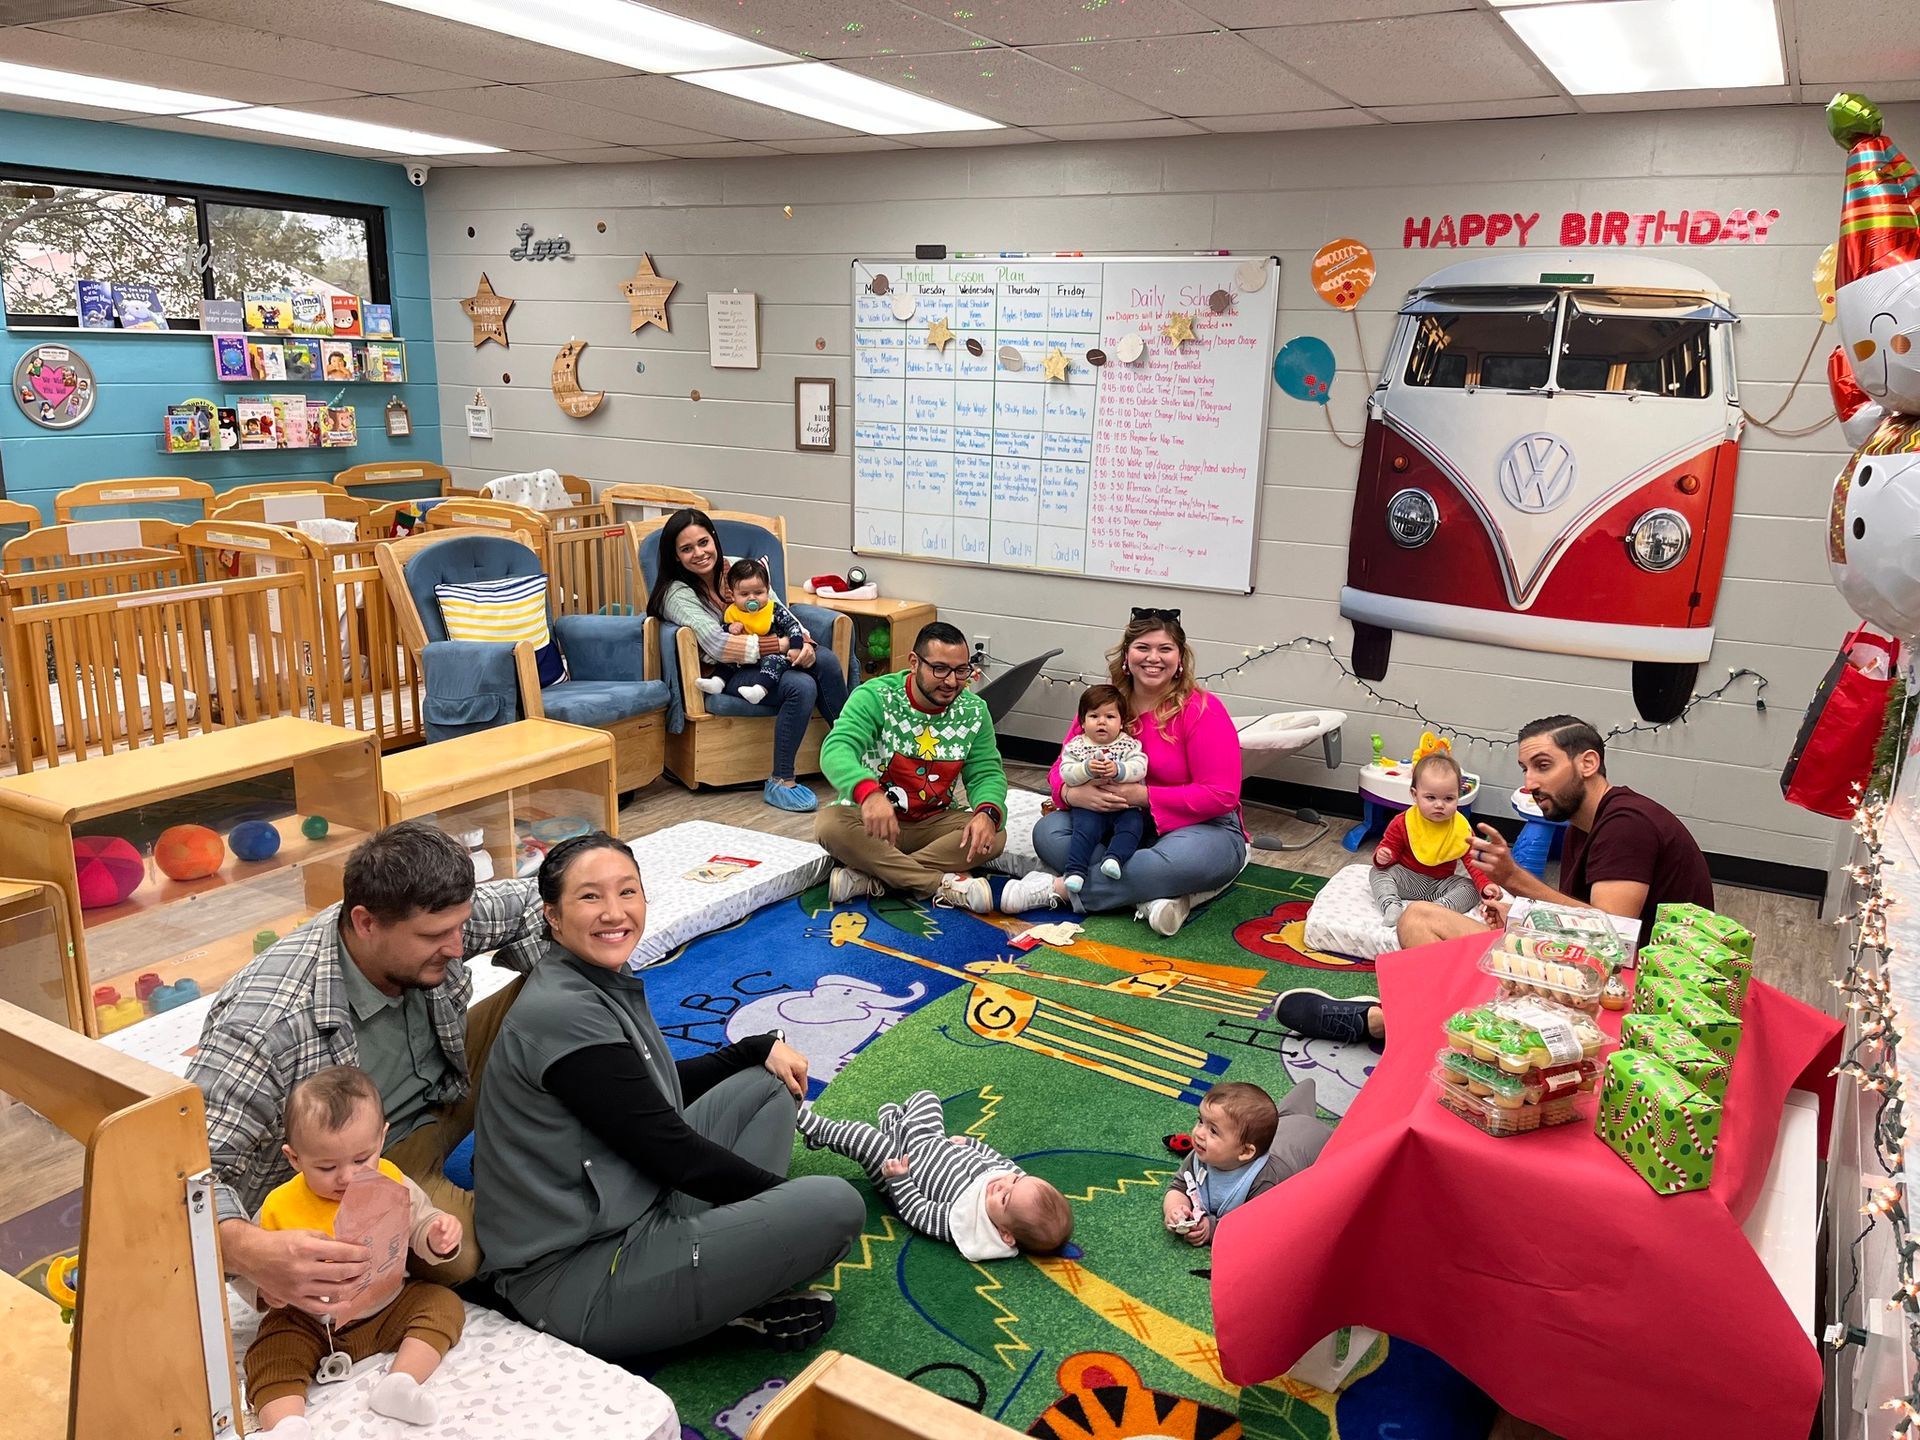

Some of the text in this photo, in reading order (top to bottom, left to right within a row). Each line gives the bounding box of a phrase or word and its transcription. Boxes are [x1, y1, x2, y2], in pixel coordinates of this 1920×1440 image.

[1403, 208, 1781, 249] HAPPY BIRTHDAY
[509, 223, 572, 261] Love
[900, 263, 1025, 283] Infant Lesson Plan
[919, 284, 946, 296] Tuesday
[959, 284, 995, 295] Wednesday
[1008, 284, 1041, 296] Thursday
[1057, 285, 1086, 298] Friday
[1131, 285, 1165, 312] Daily
[814, 414, 830, 422] BUILD
[1134, 419, 1153, 430] Lunch
[973, 996, 1016, 1030] G
